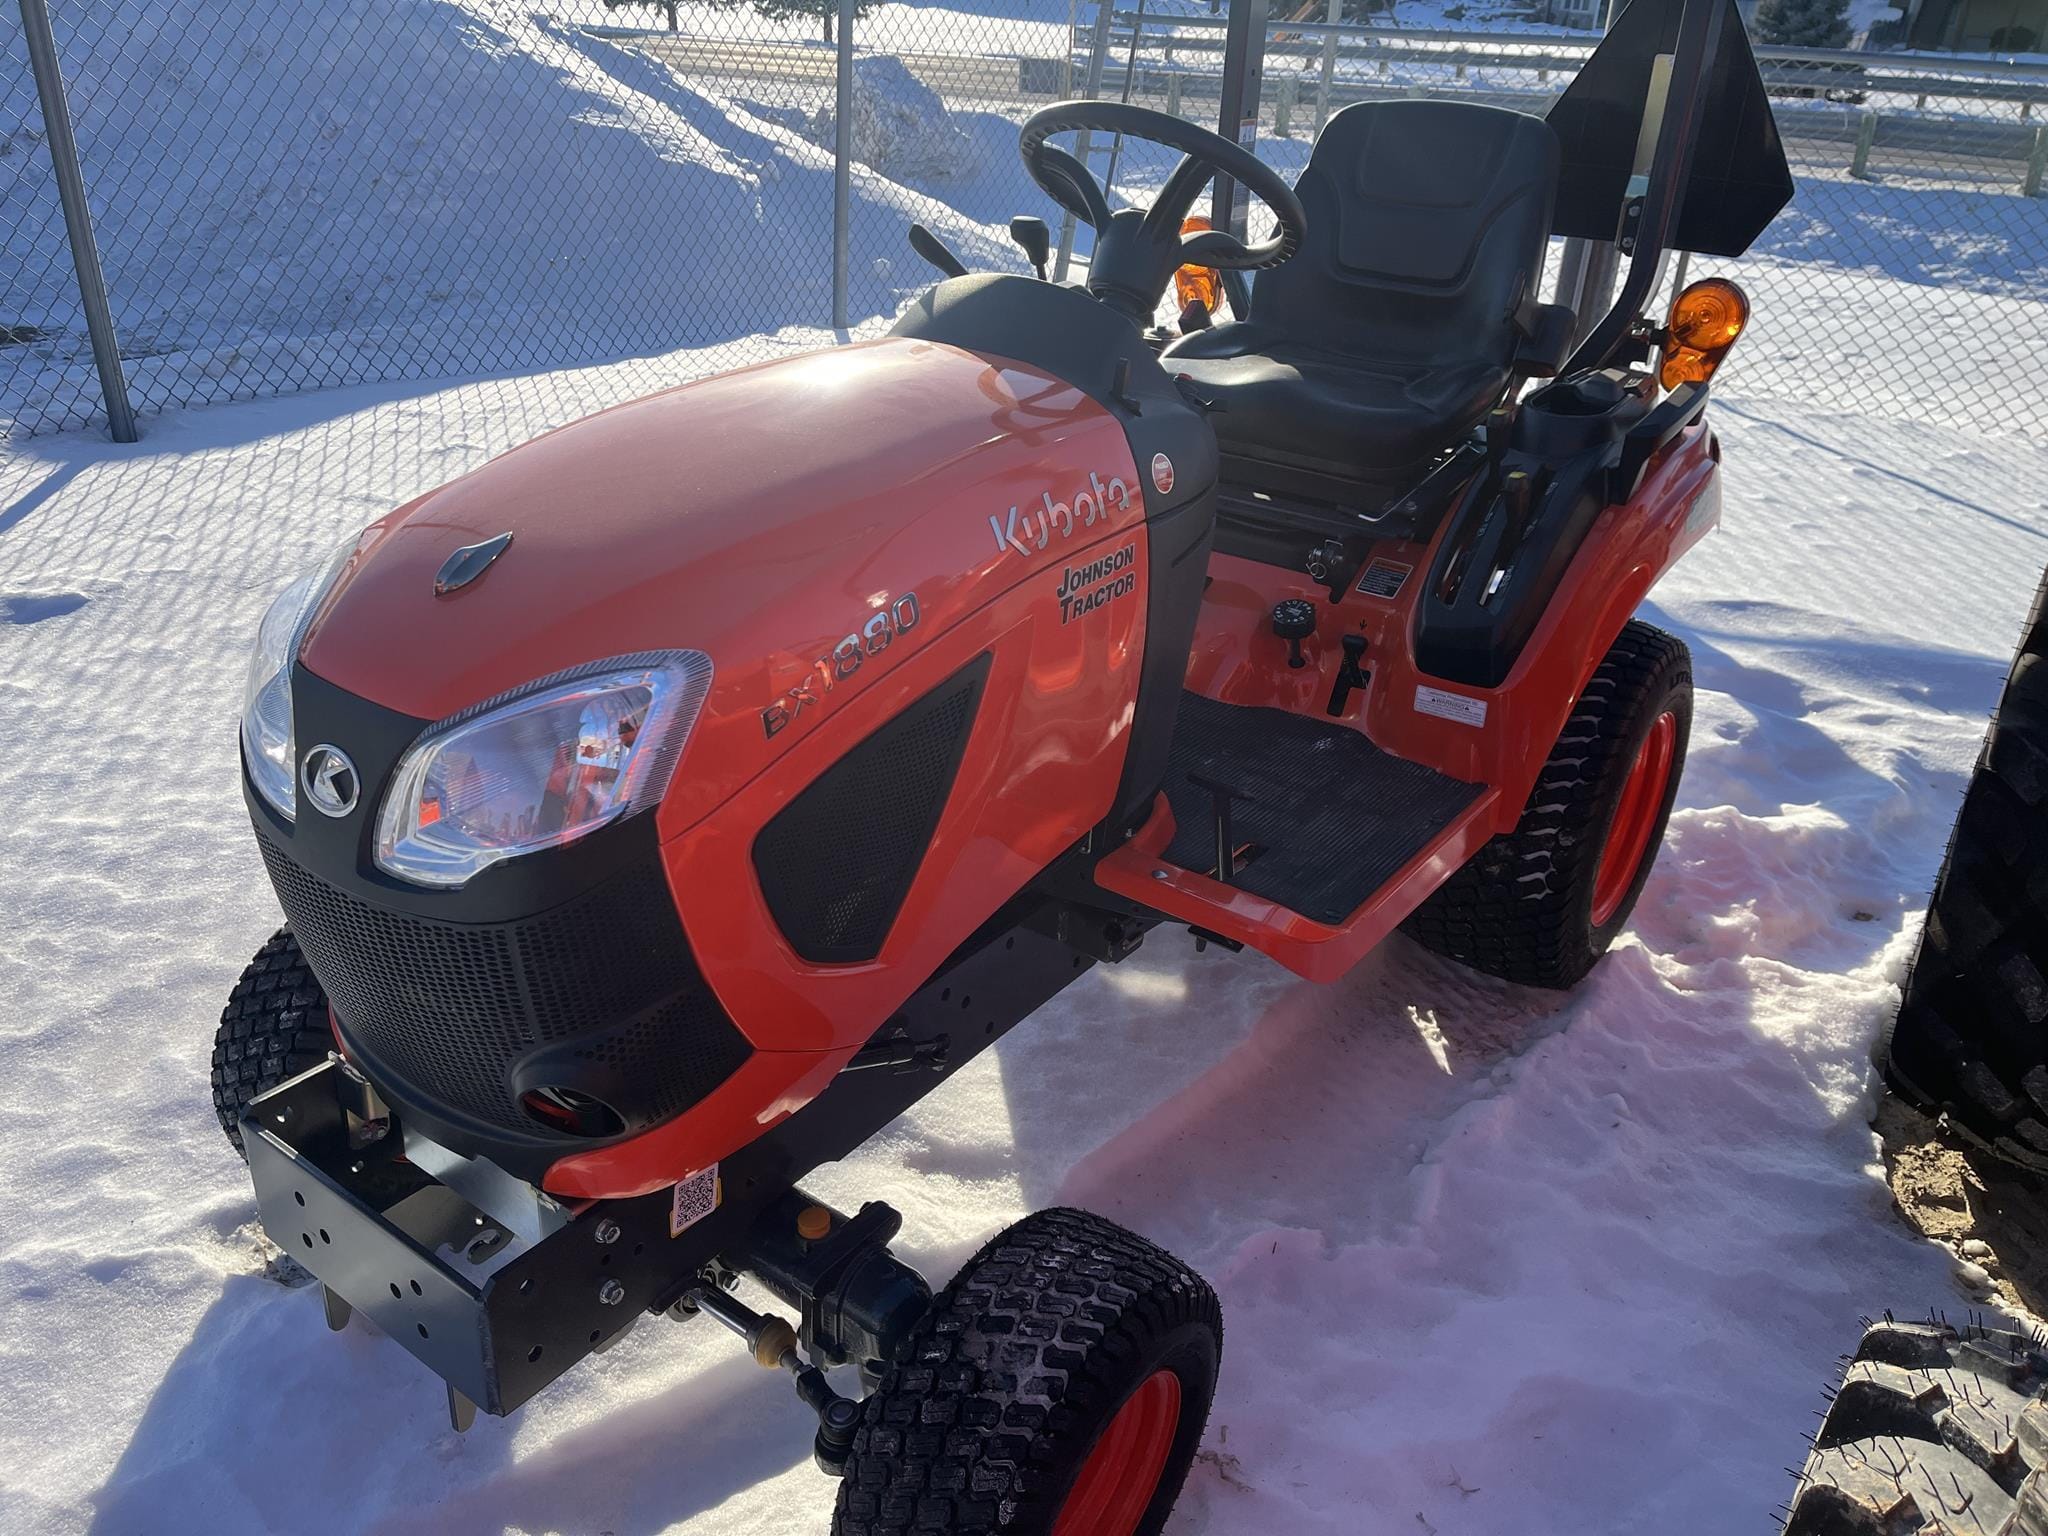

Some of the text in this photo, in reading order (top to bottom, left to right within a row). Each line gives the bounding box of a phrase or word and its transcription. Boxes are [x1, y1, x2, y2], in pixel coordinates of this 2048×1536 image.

[988, 471, 1130, 557] Kubota
[1056, 543, 1136, 599] JOHNSON
[1060, 573, 1136, 625] TRACTOR
[760, 591, 921, 740] BX1880
